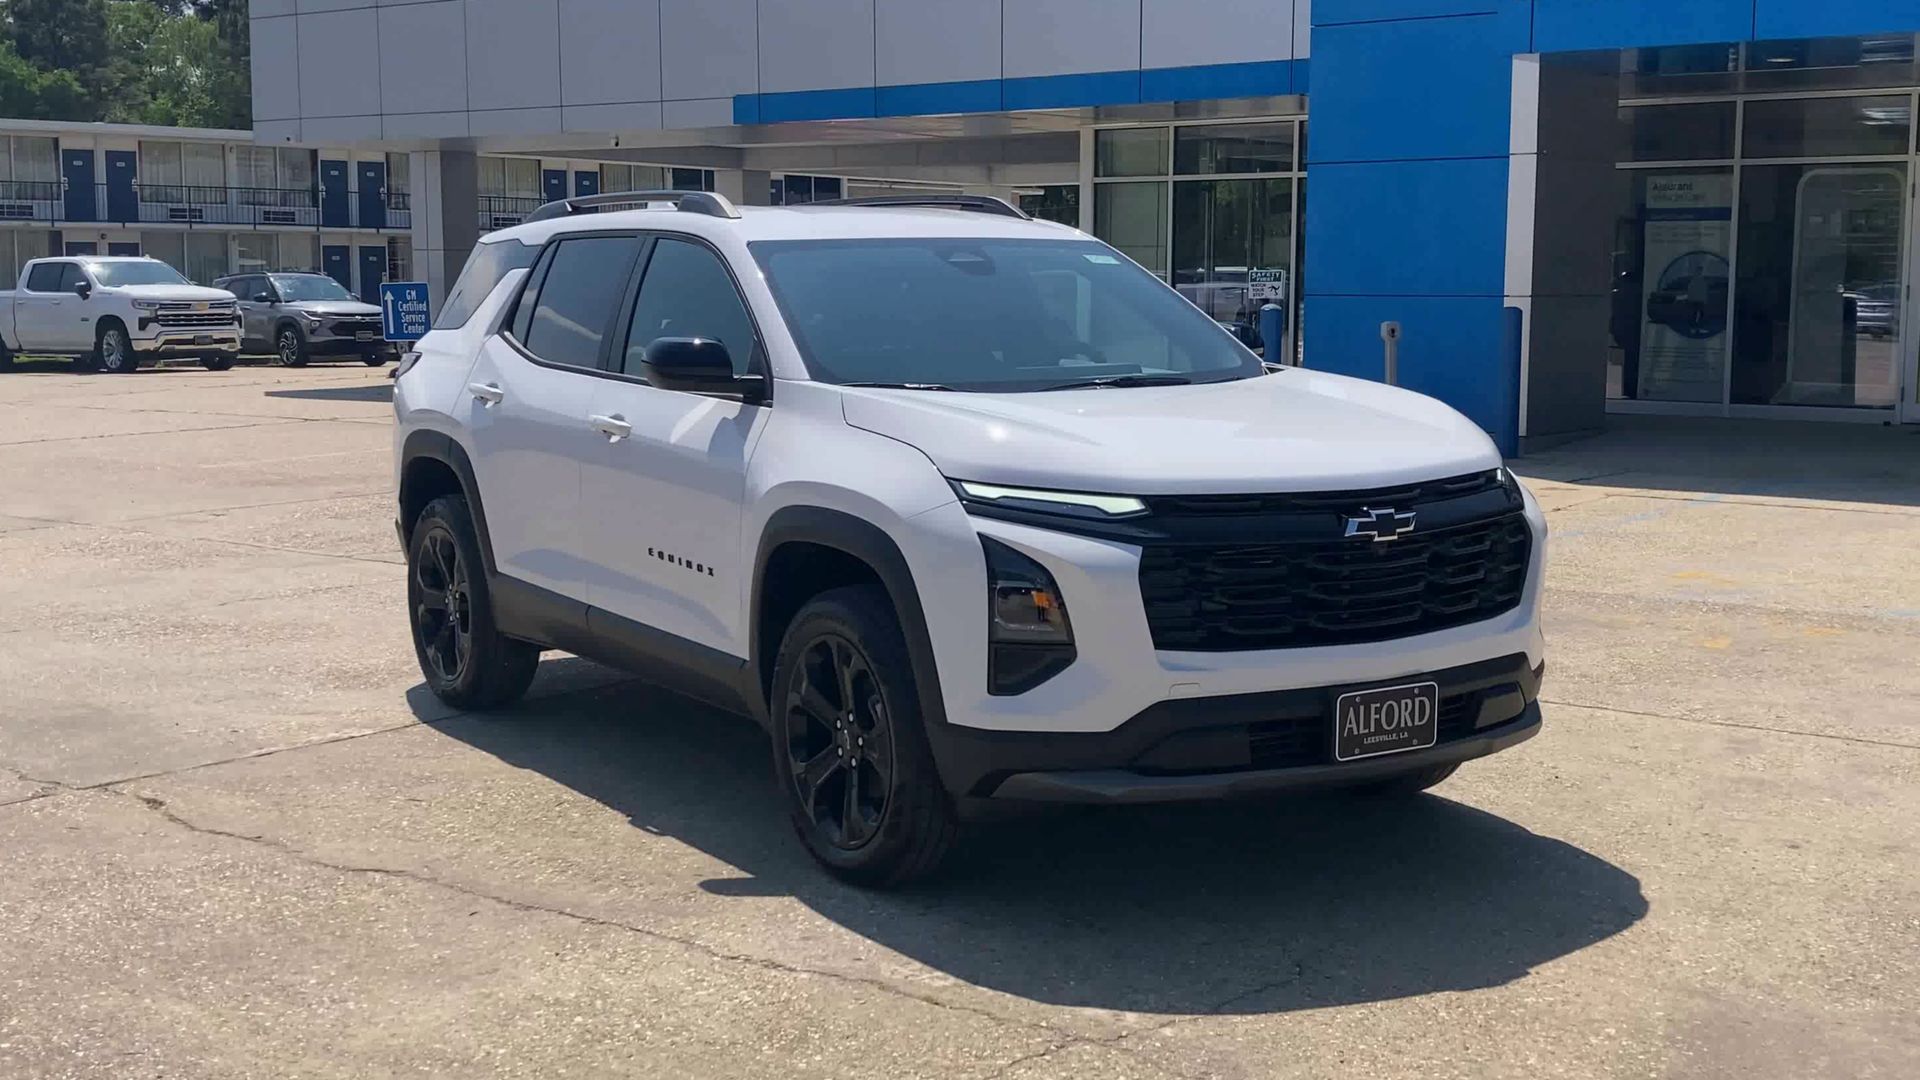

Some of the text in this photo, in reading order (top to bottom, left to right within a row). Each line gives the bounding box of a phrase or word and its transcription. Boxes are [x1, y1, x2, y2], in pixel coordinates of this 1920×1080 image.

[405, 289, 417, 301] GM
[397, 301, 427, 312] Certified
[401, 312, 426, 323] Service
[403, 323, 425, 334] Center
[648, 547, 714, 577] EQUINOX
[1343, 696, 1431, 737] ALFORD
[1363, 731, 1409, 744] LEESVILLE, LA
